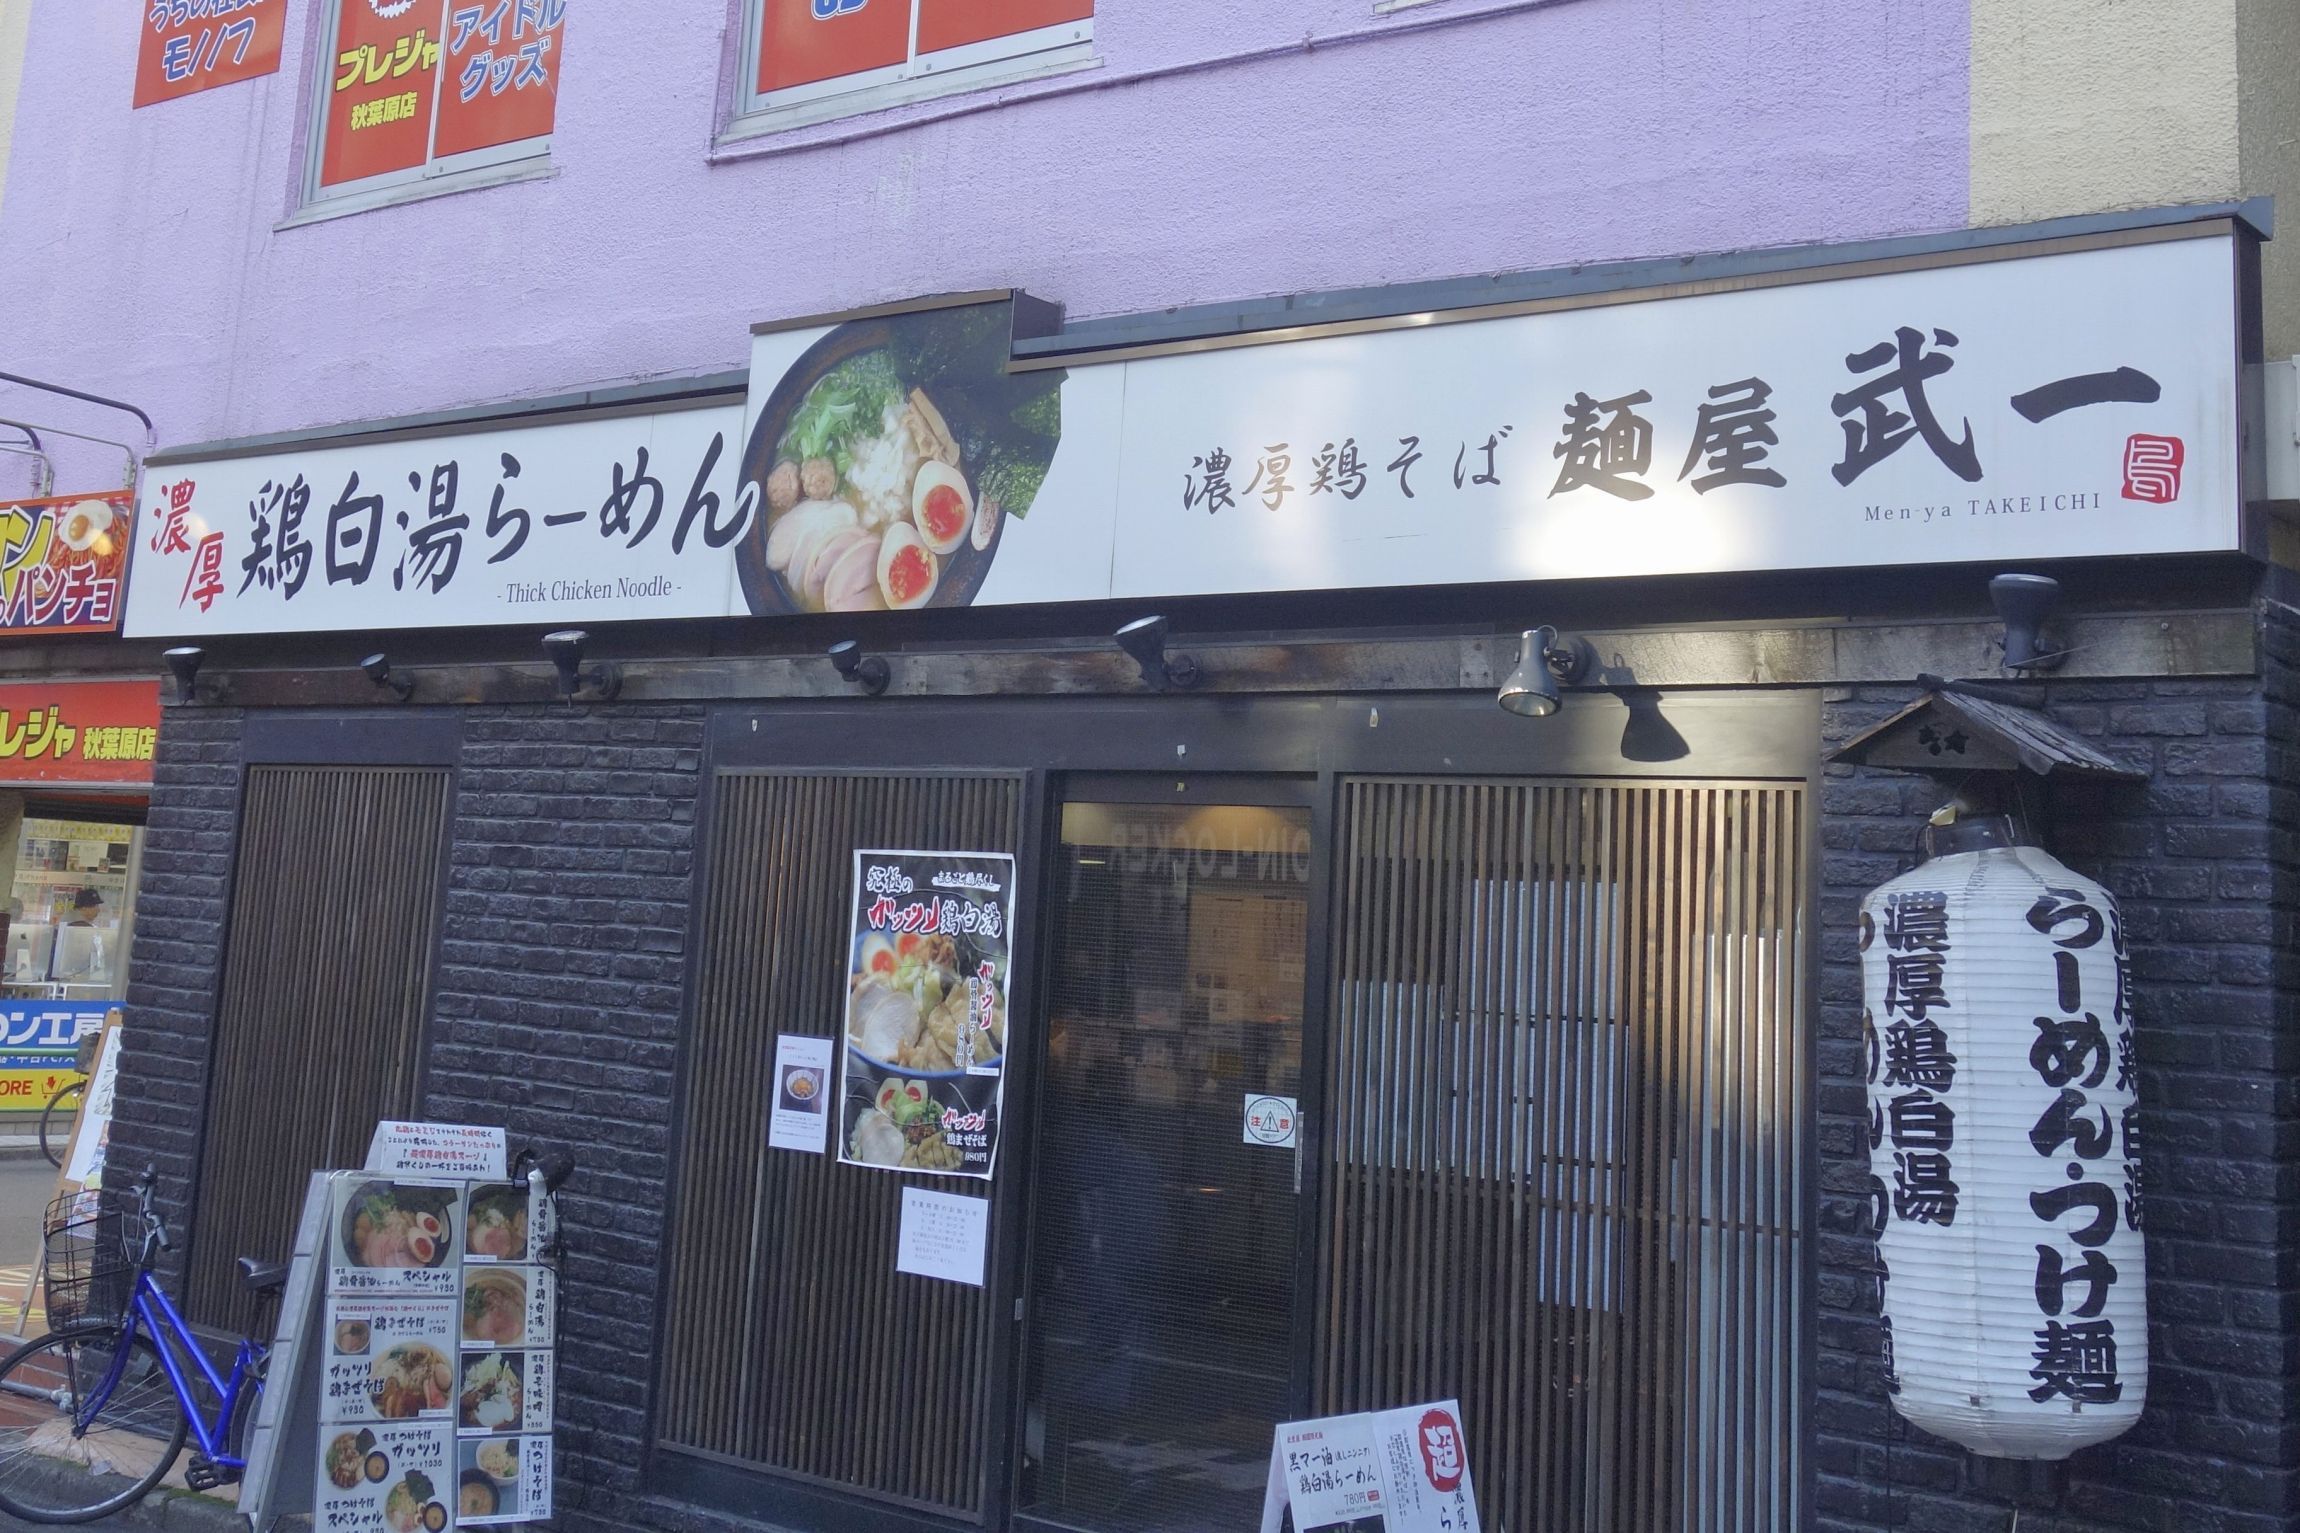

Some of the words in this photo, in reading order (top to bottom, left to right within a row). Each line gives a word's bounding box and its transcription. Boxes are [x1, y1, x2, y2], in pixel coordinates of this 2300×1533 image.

[162, 17, 256, 82] モノノフ
[459, 35, 552, 104] グッズ
[351, 91, 417, 130] 秋葉原店
[1183, 425, 1513, 515] 濃厚鶏そば
[236, 431, 754, 601] 鶏白湯らーめん
[1865, 504, 1952, 523] Men-ya
[1968, 492, 2101, 516] TAKEICHI
[151, 478, 225, 613] 濃厚
[506, 581, 547, 603] Thick
[551, 578, 612, 601] Chicken
[616, 575, 672, 599] Noodle
[83, 726, 157, 760] 秋葉原店
[866, 866, 914, 893] 究極の
[1883, 890, 1960, 1227] 濃厚鶏白湯
[403, 1270, 452, 1282] スペシャル
[329, 1361, 372, 1378] ガッツリ
[392, 1441, 441, 1458] ガッツリ
[327, 1510, 383, 1528] スペシャル
